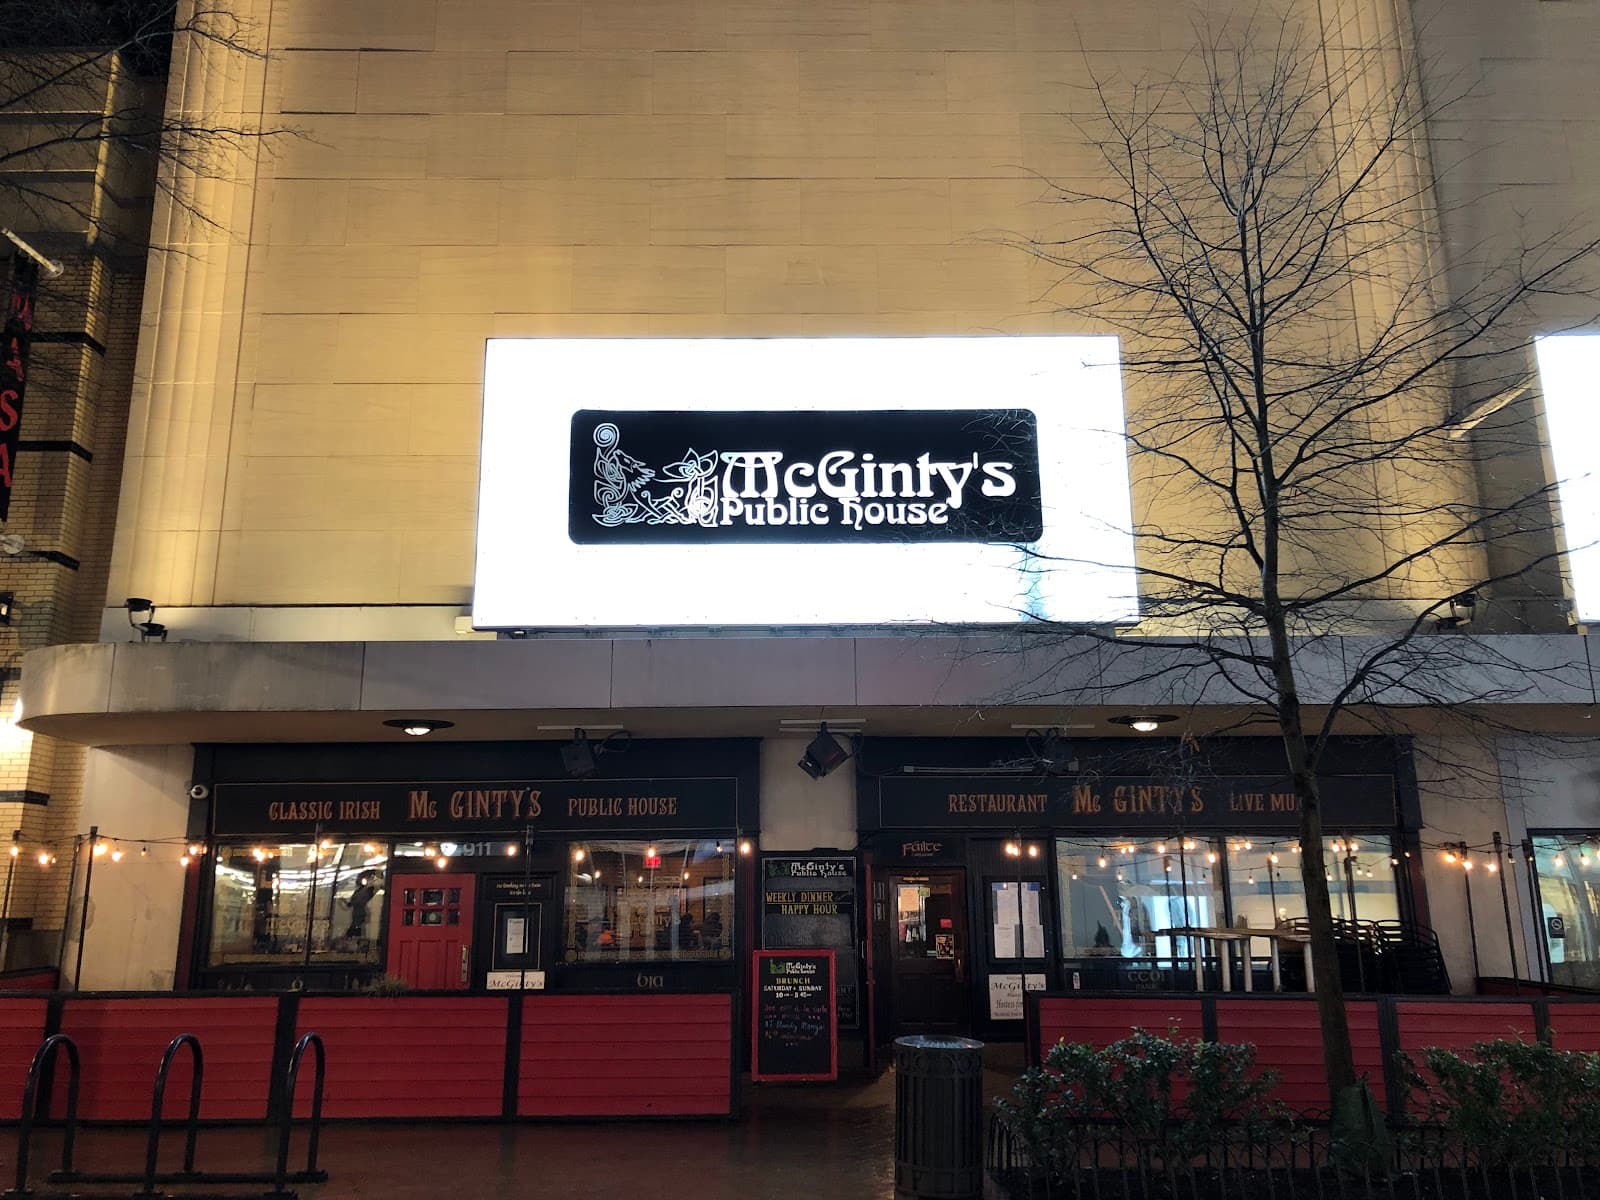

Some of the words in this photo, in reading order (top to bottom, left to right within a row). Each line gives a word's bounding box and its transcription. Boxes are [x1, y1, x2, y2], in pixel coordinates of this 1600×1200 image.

[720, 450, 1017, 509] McGinty's
[720, 497, 829, 527] Public
[449, 786, 543, 820] GINTY'S
[949, 793, 1048, 814] RESTAURANT
[1113, 784, 1205, 814] GINTYS
[1230, 792, 1265, 812] LIVE
[268, 800, 333, 821] CLASSIC
[339, 800, 382, 821] IRISH
[567, 797, 624, 817] PUBLIC
[627, 796, 678, 816] HOUSE
[463, 843, 491, 857] 911
[790, 861, 845, 873] McGinty's
[791, 869, 818, 878] Public
[765, 891, 797, 904] WEEKLY
[801, 891, 834, 903] DINNER
[781, 904, 810, 915] HAPPY
[813, 904, 839, 915] HOUR
[489, 979, 544, 990] McGity's
[775, 976, 811, 985] BRUNCH
[993, 982, 1045, 992] McGity's
[763, 984, 793, 992] SATURDAY
[798, 984, 823, 992] SUNDAY
